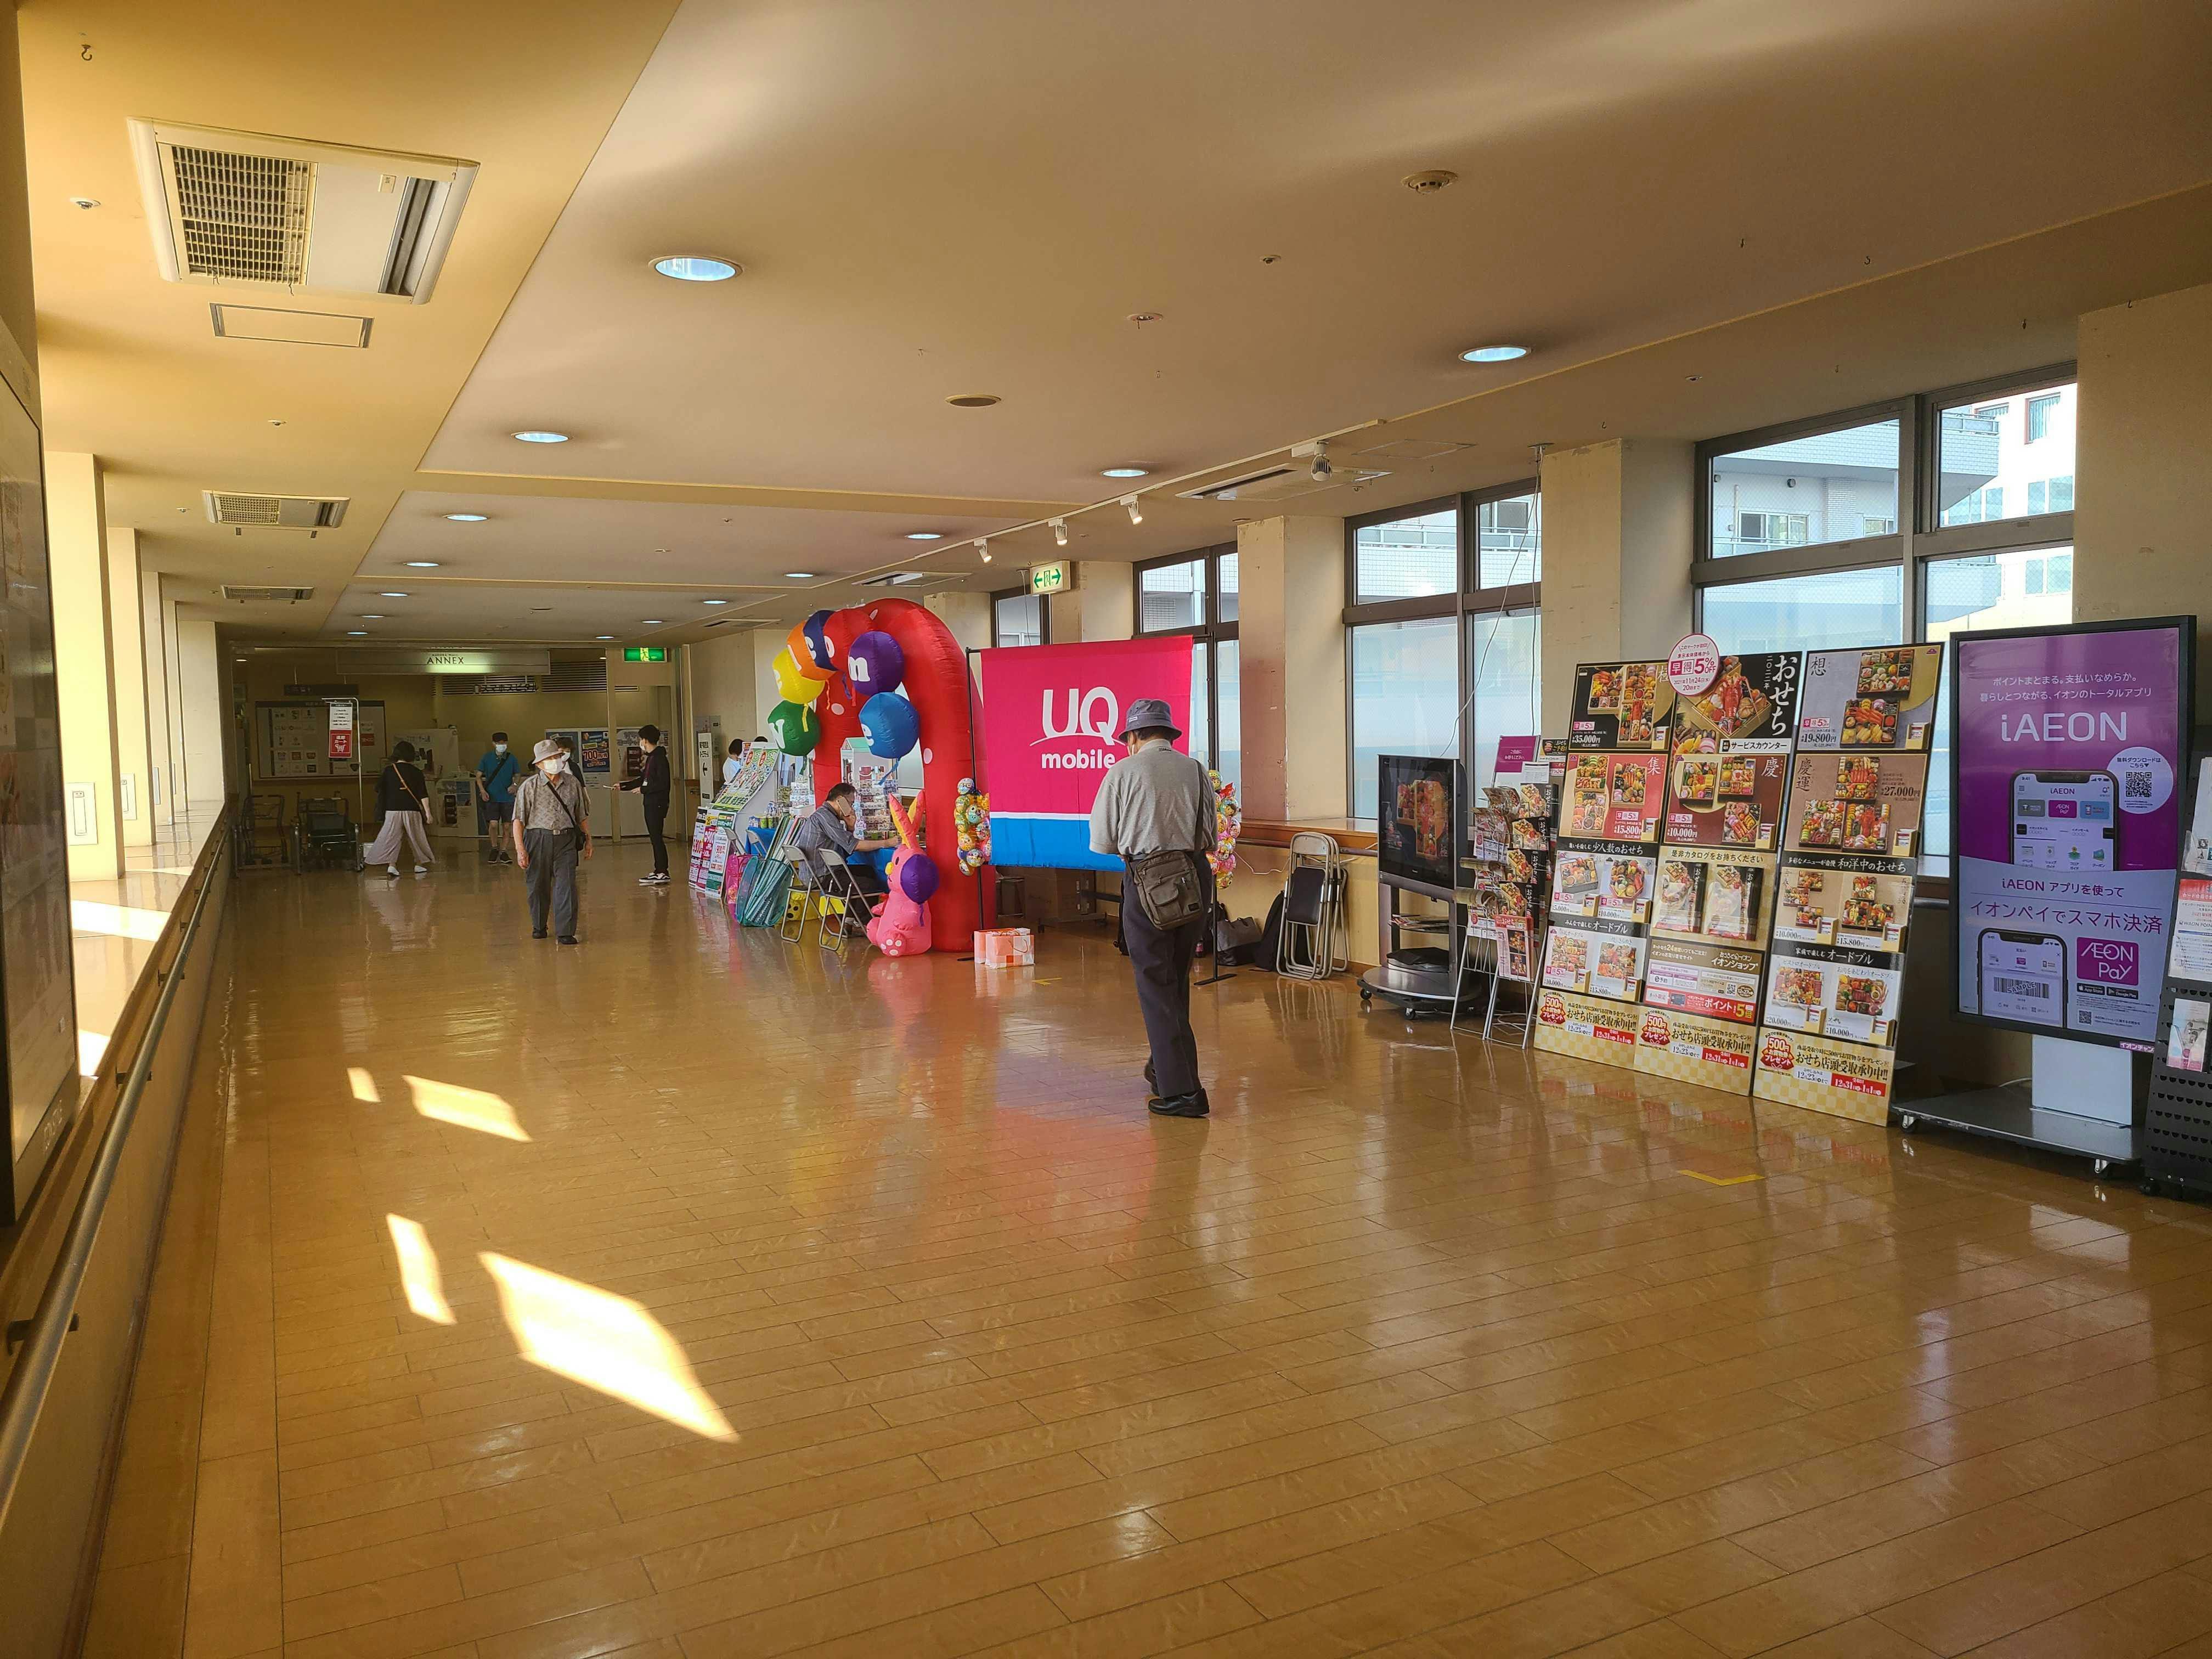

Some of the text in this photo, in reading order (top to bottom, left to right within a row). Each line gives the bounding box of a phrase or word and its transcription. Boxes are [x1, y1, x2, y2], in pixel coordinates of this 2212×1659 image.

[1810, 656, 1827, 676] 想
[1993, 672, 2137, 687] ポイントまとまる。支払いなめらか。
[1769, 654, 1798, 736] おせち
[1979, 687, 2152, 702] 暮らしとつながる、イオンのトータルアプリ
[1042, 686, 1119, 747] UQ
[2001, 712, 2127, 742] iAEON
[1731, 740, 1787, 749] サービスカウンター
[1804, 732, 1837, 743] 19,800円
[1041, 749, 1116, 769] mobile
[1647, 757, 1661, 775] 集
[1761, 757, 1779, 778] 慶
[1795, 758, 1812, 792] 慶運
[1884, 786, 1920, 797] 27,000円
[1670, 827, 1698, 838] 10,000円
[1593, 842, 1644, 855] 少人数のおせち
[1671, 850, 1764, 864] 是非カタログをお持ちください
[1838, 858, 1907, 873] 和洋中のおせち
[2002, 878, 2125, 898] iAEON アプリを使って
[1970, 900, 2163, 935] イオンペイでスマホ決済
[1593, 921, 1629, 934] オードブル
[1778, 930, 1802, 940] 10,000円
[1839, 936, 1865, 948] 15,800円
[1711, 957, 1759, 971] イオンショップ
[1827, 950, 1875, 964] オードブル
[2098, 962, 2134, 980] Pay
[2007, 981, 2036, 994] SAMPLE
[1545, 997, 1562, 1009] 500円
[1705, 998, 1733, 1011] ポイント
[1543, 1012, 1564, 1021] プレゼント
[1647, 1015, 1667, 1029] 500円
[1768, 1017, 1791, 1028] 20,000円
[1644, 1031, 1668, 1042] プレゼント
[1829, 1028, 1854, 1037] 10,000円
[1768, 1037, 1790, 1052] 500円
[2120, 1042, 2155, 1054] イオンチャン
[1764, 1054, 1791, 1066] プレゼント
